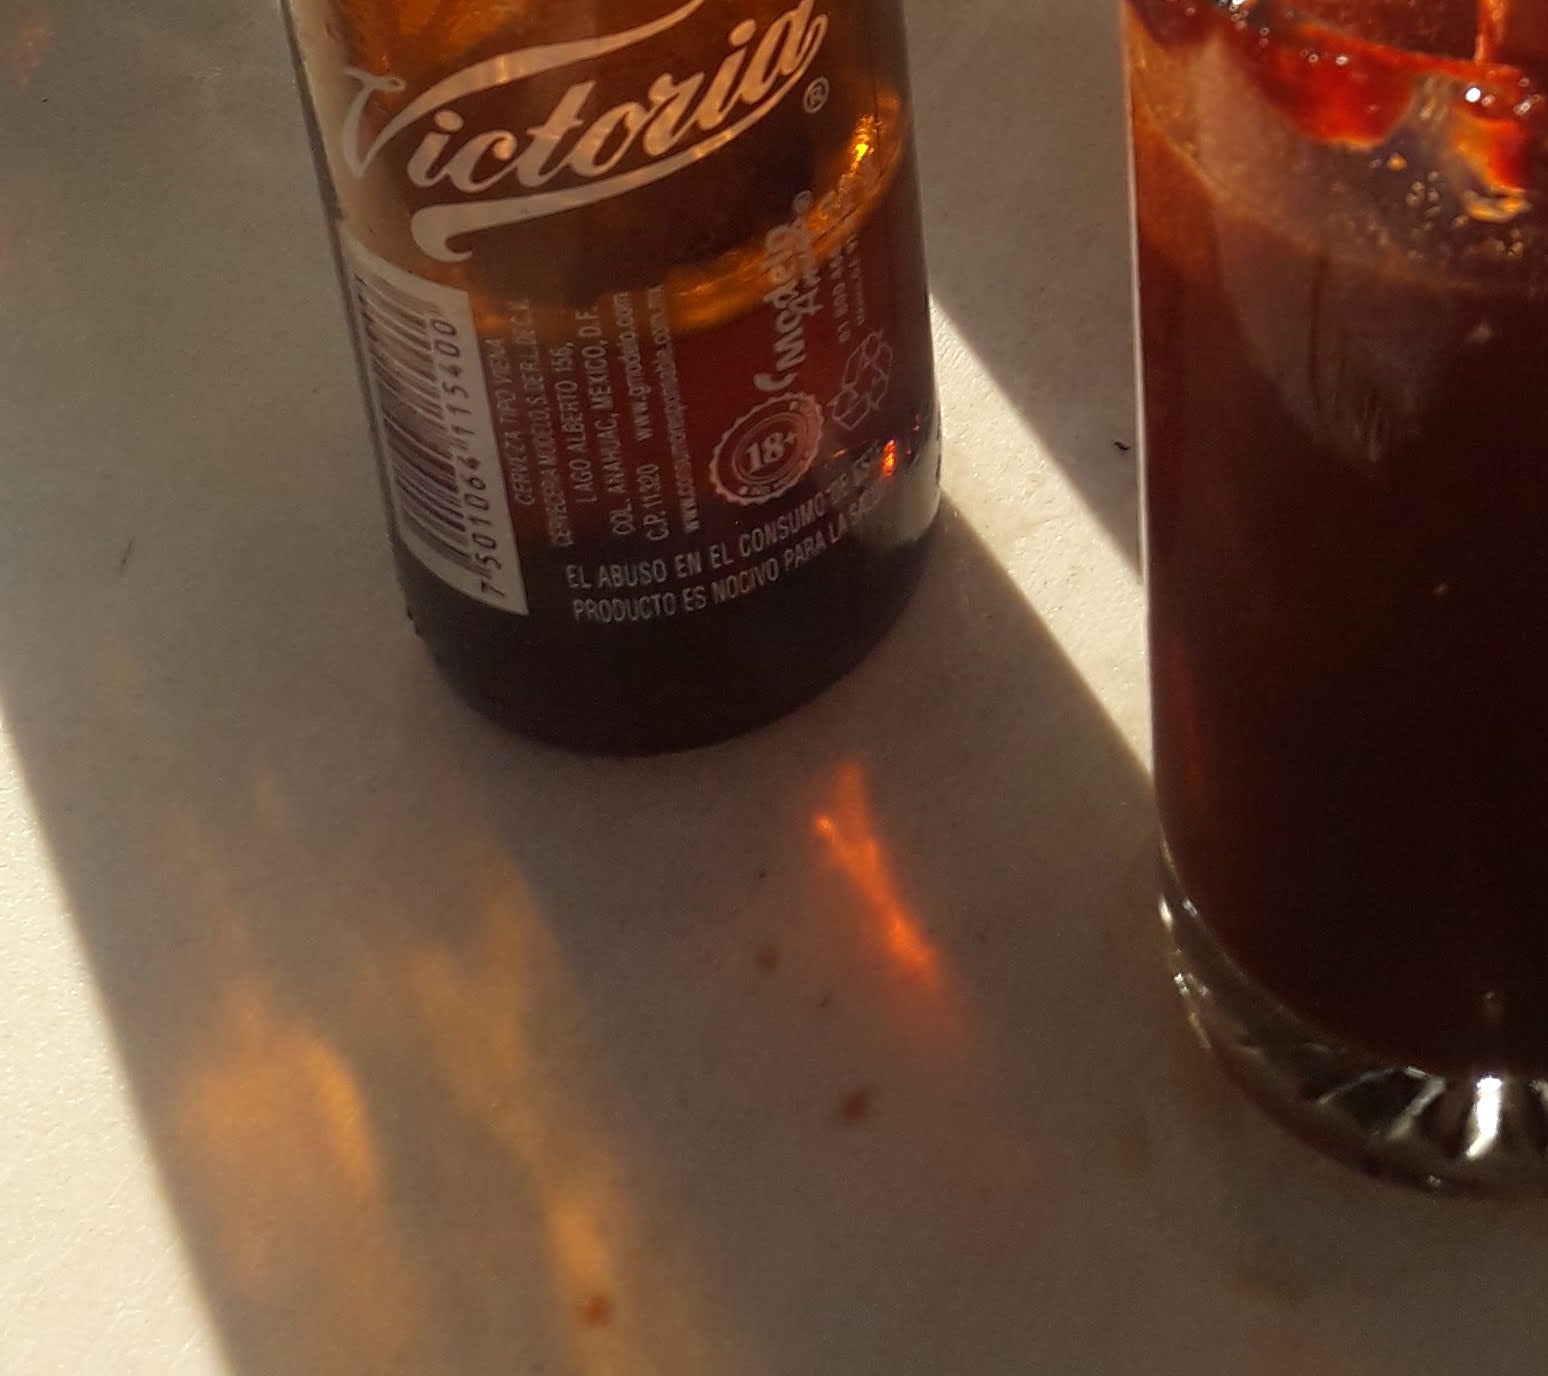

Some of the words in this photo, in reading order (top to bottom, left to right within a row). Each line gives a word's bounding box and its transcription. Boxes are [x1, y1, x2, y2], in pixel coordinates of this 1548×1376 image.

[554, 379, 587, 454] ALBERTO
[568, 458, 598, 505] LAGO
[565, 563, 591, 589] EL
[597, 558, 668, 589] ABUSO
[675, 551, 702, 579] EN
[709, 542, 734, 570] EL
[738, 492, 827, 557] CONSUMO
[572, 592, 677, 624] PRODUCTO
[682, 585, 707, 613] ES
[711, 556, 779, 605] NOCIVO
